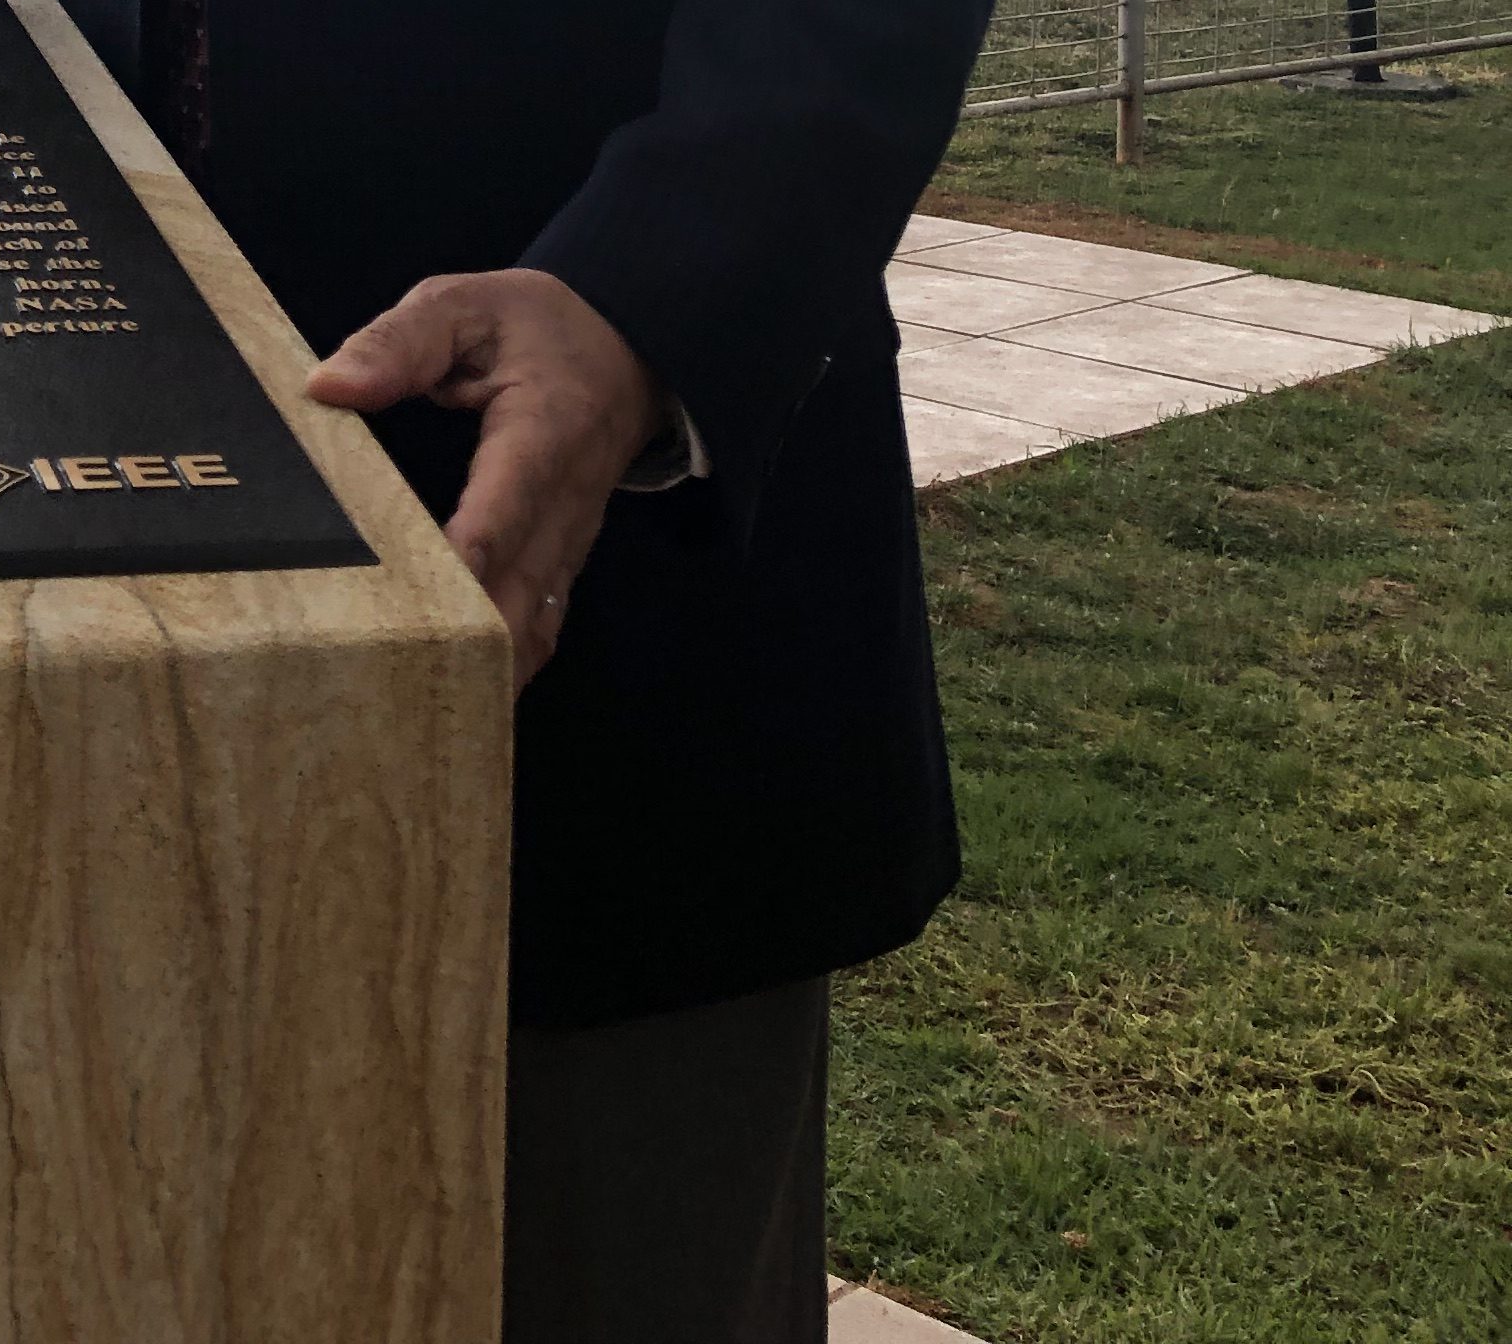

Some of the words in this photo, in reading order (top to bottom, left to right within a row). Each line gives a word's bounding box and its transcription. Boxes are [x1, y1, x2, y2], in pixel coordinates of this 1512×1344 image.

[22, 185, 56, 196] to
[55, 237, 89, 251] of
[45, 257, 101, 271] the
[15, 297, 127, 312] NASA
[30, 455, 239, 490] IEEE
